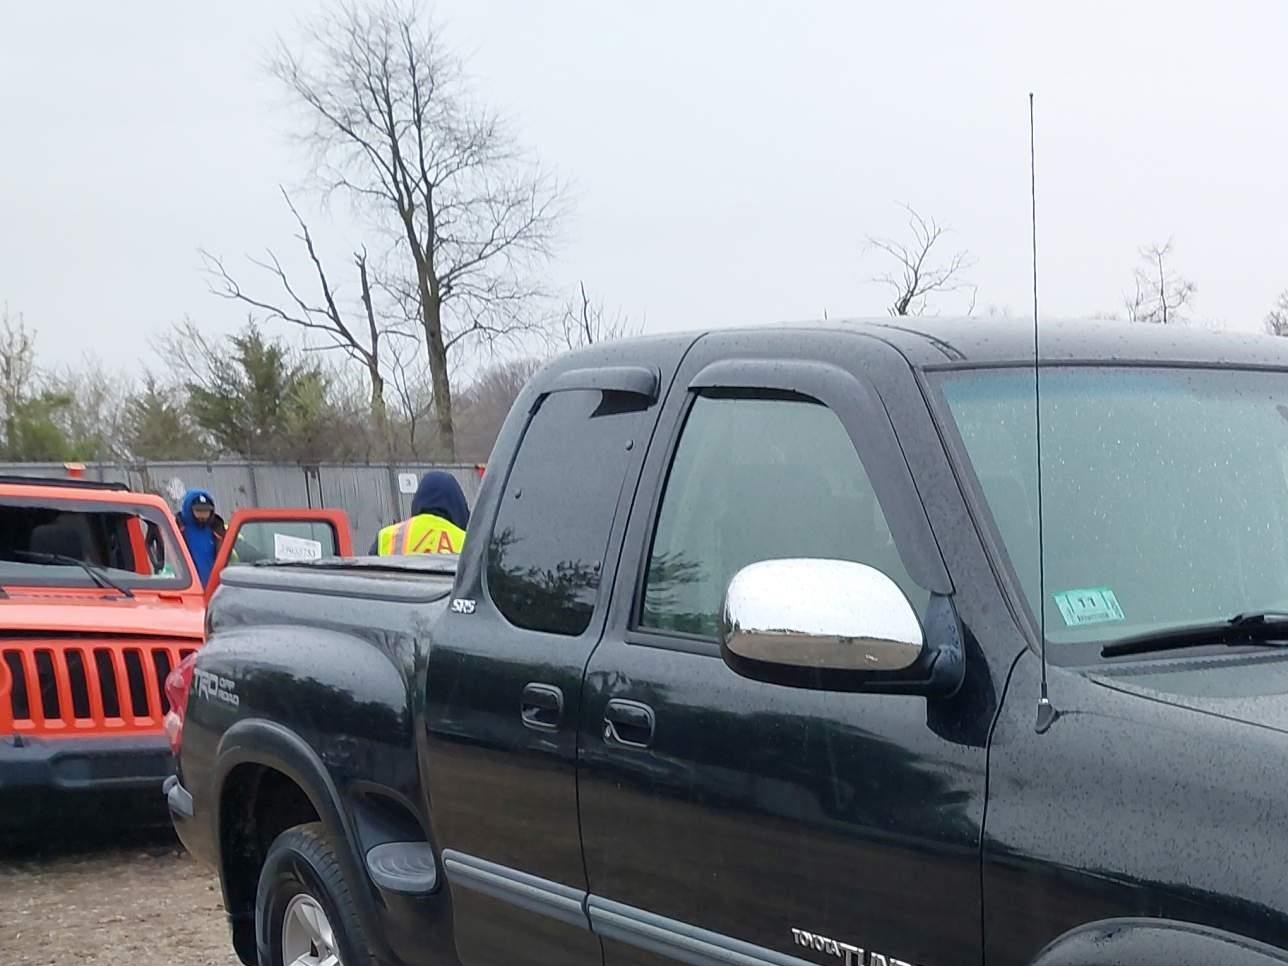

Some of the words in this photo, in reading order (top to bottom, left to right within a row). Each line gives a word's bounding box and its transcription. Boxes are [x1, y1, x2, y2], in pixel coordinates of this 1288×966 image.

[194, 669, 219, 701] TRD
[218, 689, 240, 706] ROAD
[791, 927, 842, 958] TOYOTA
